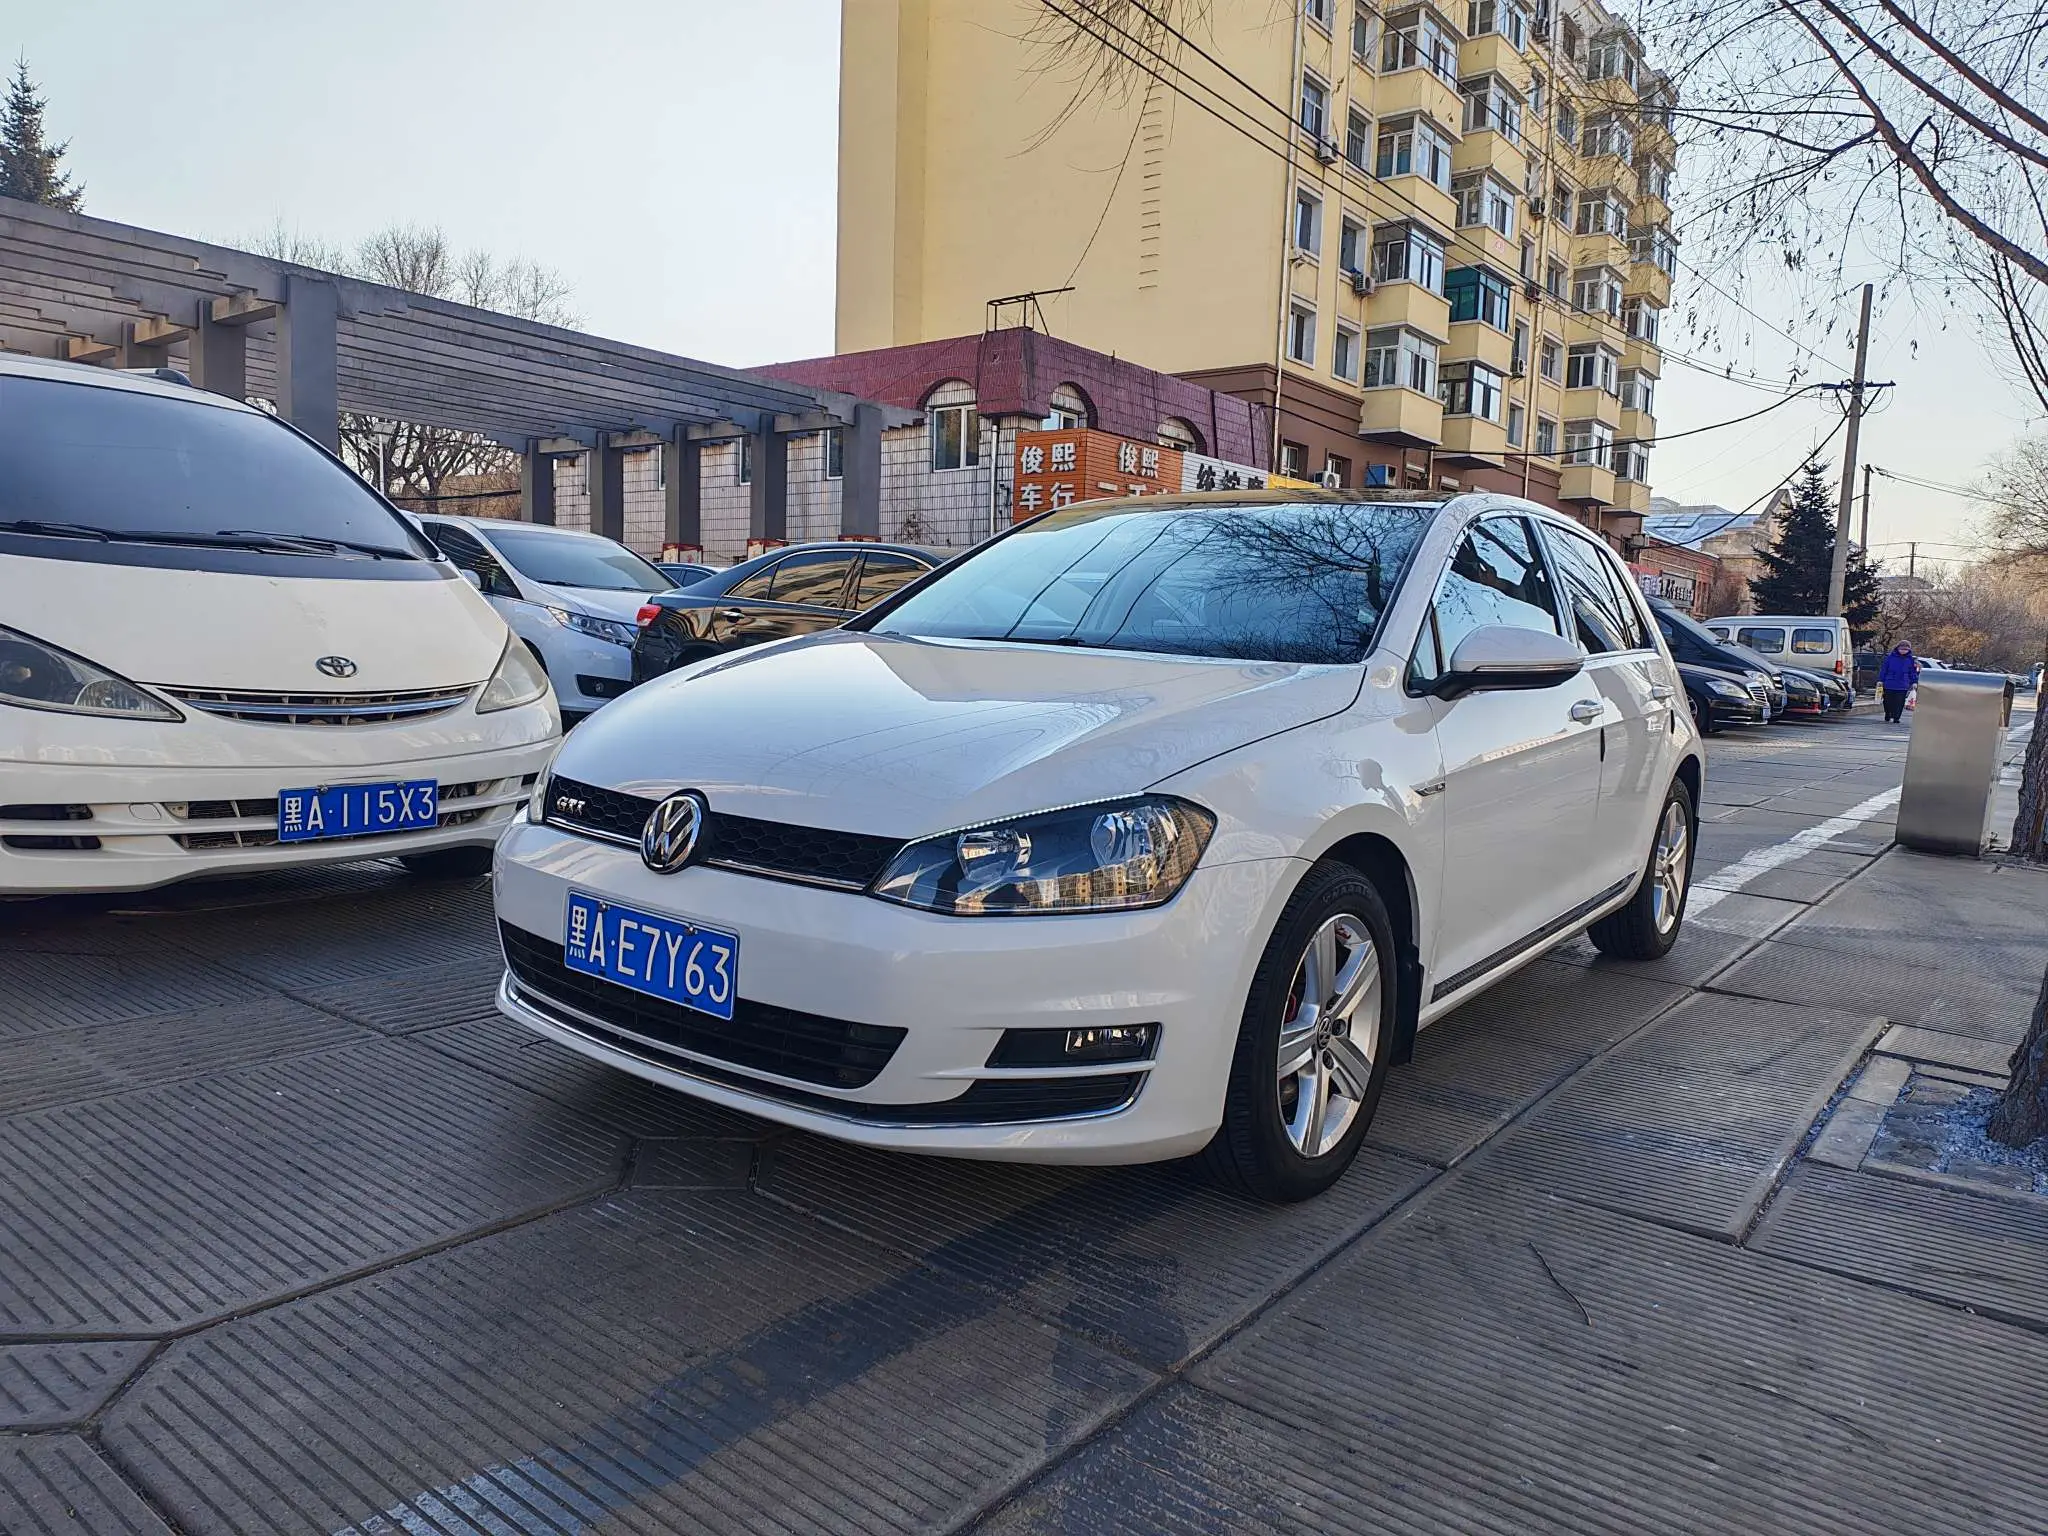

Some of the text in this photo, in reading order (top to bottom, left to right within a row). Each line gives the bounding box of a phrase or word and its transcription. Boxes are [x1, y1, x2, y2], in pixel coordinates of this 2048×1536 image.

[1020, 442, 1077, 475] 俊熙
[1118, 441, 1160, 480] 俊熙
[1019, 481, 1077, 511] 车行
